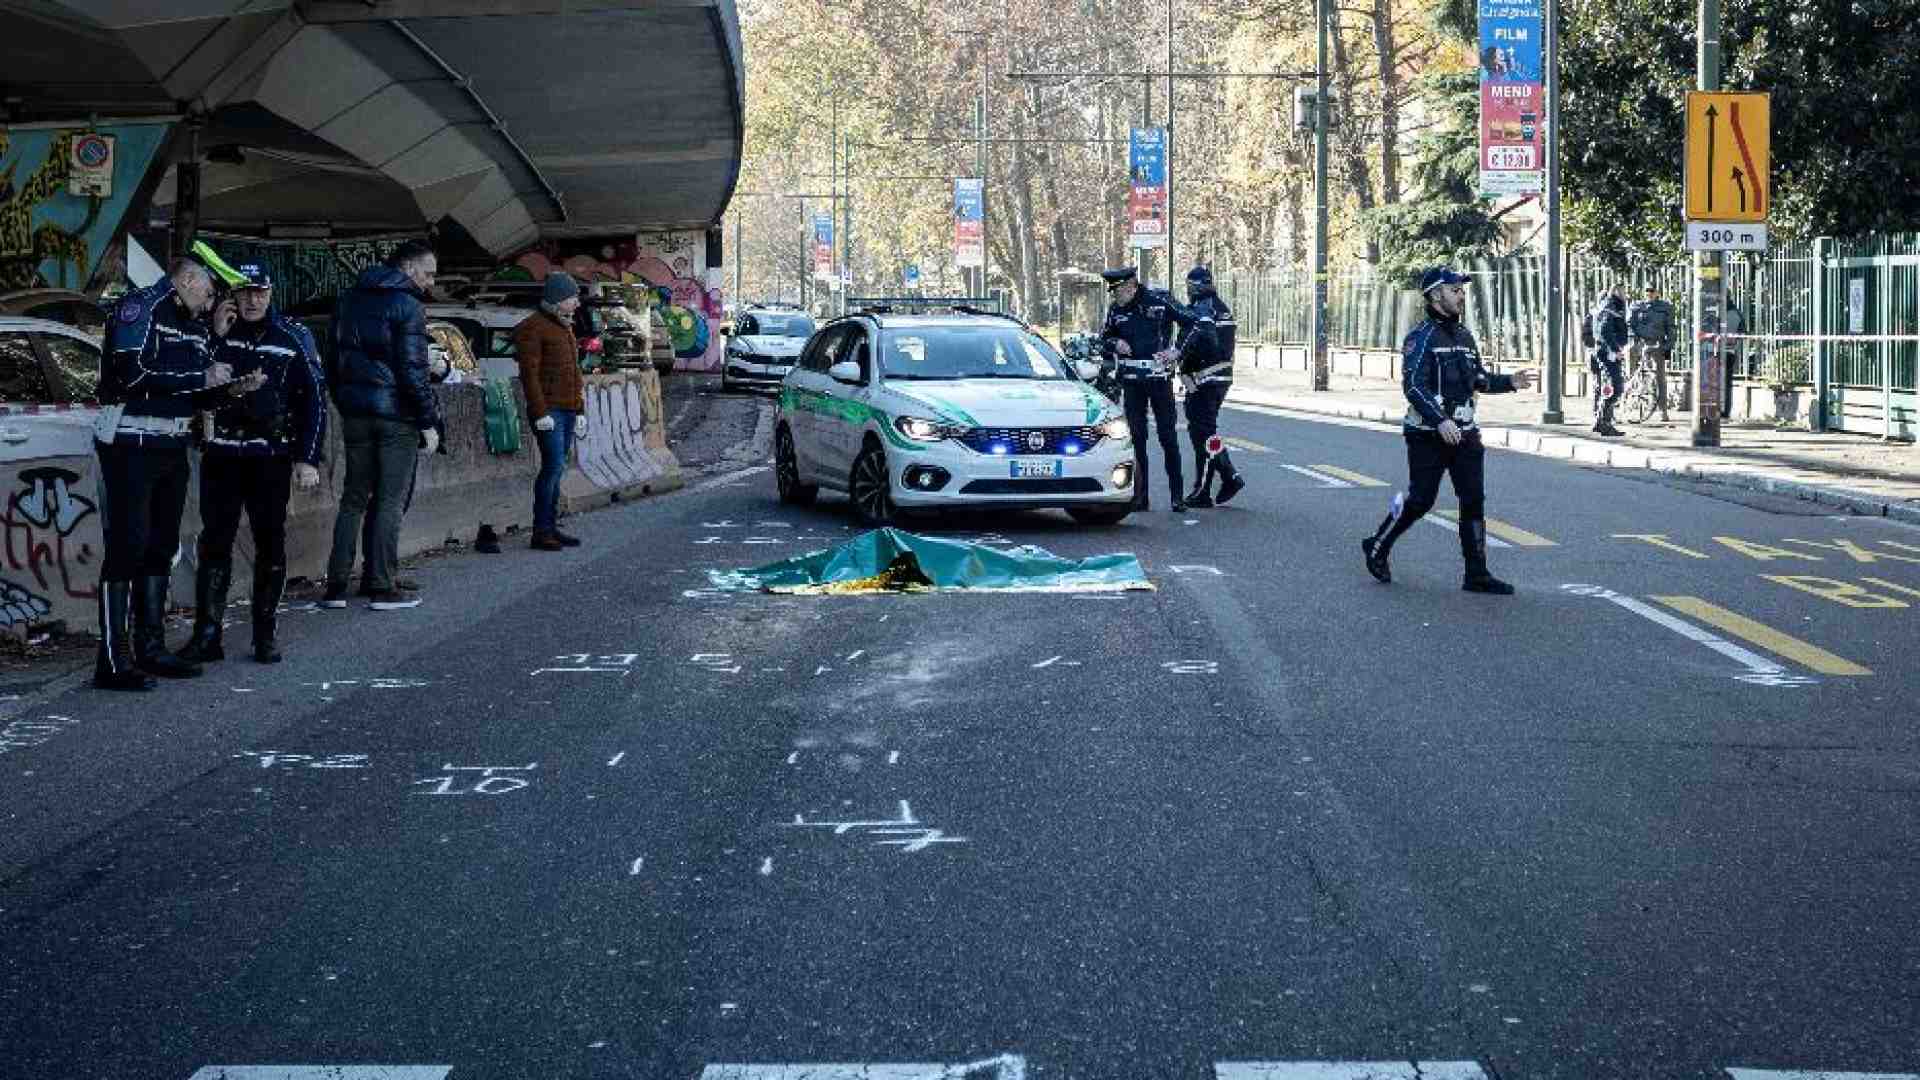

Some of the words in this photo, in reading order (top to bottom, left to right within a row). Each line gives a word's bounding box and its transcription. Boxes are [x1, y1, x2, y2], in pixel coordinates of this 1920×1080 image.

[1495, 28, 1528, 40] FILM
[1700, 230, 1734, 243] 300
[1740, 232, 1755, 243] m
